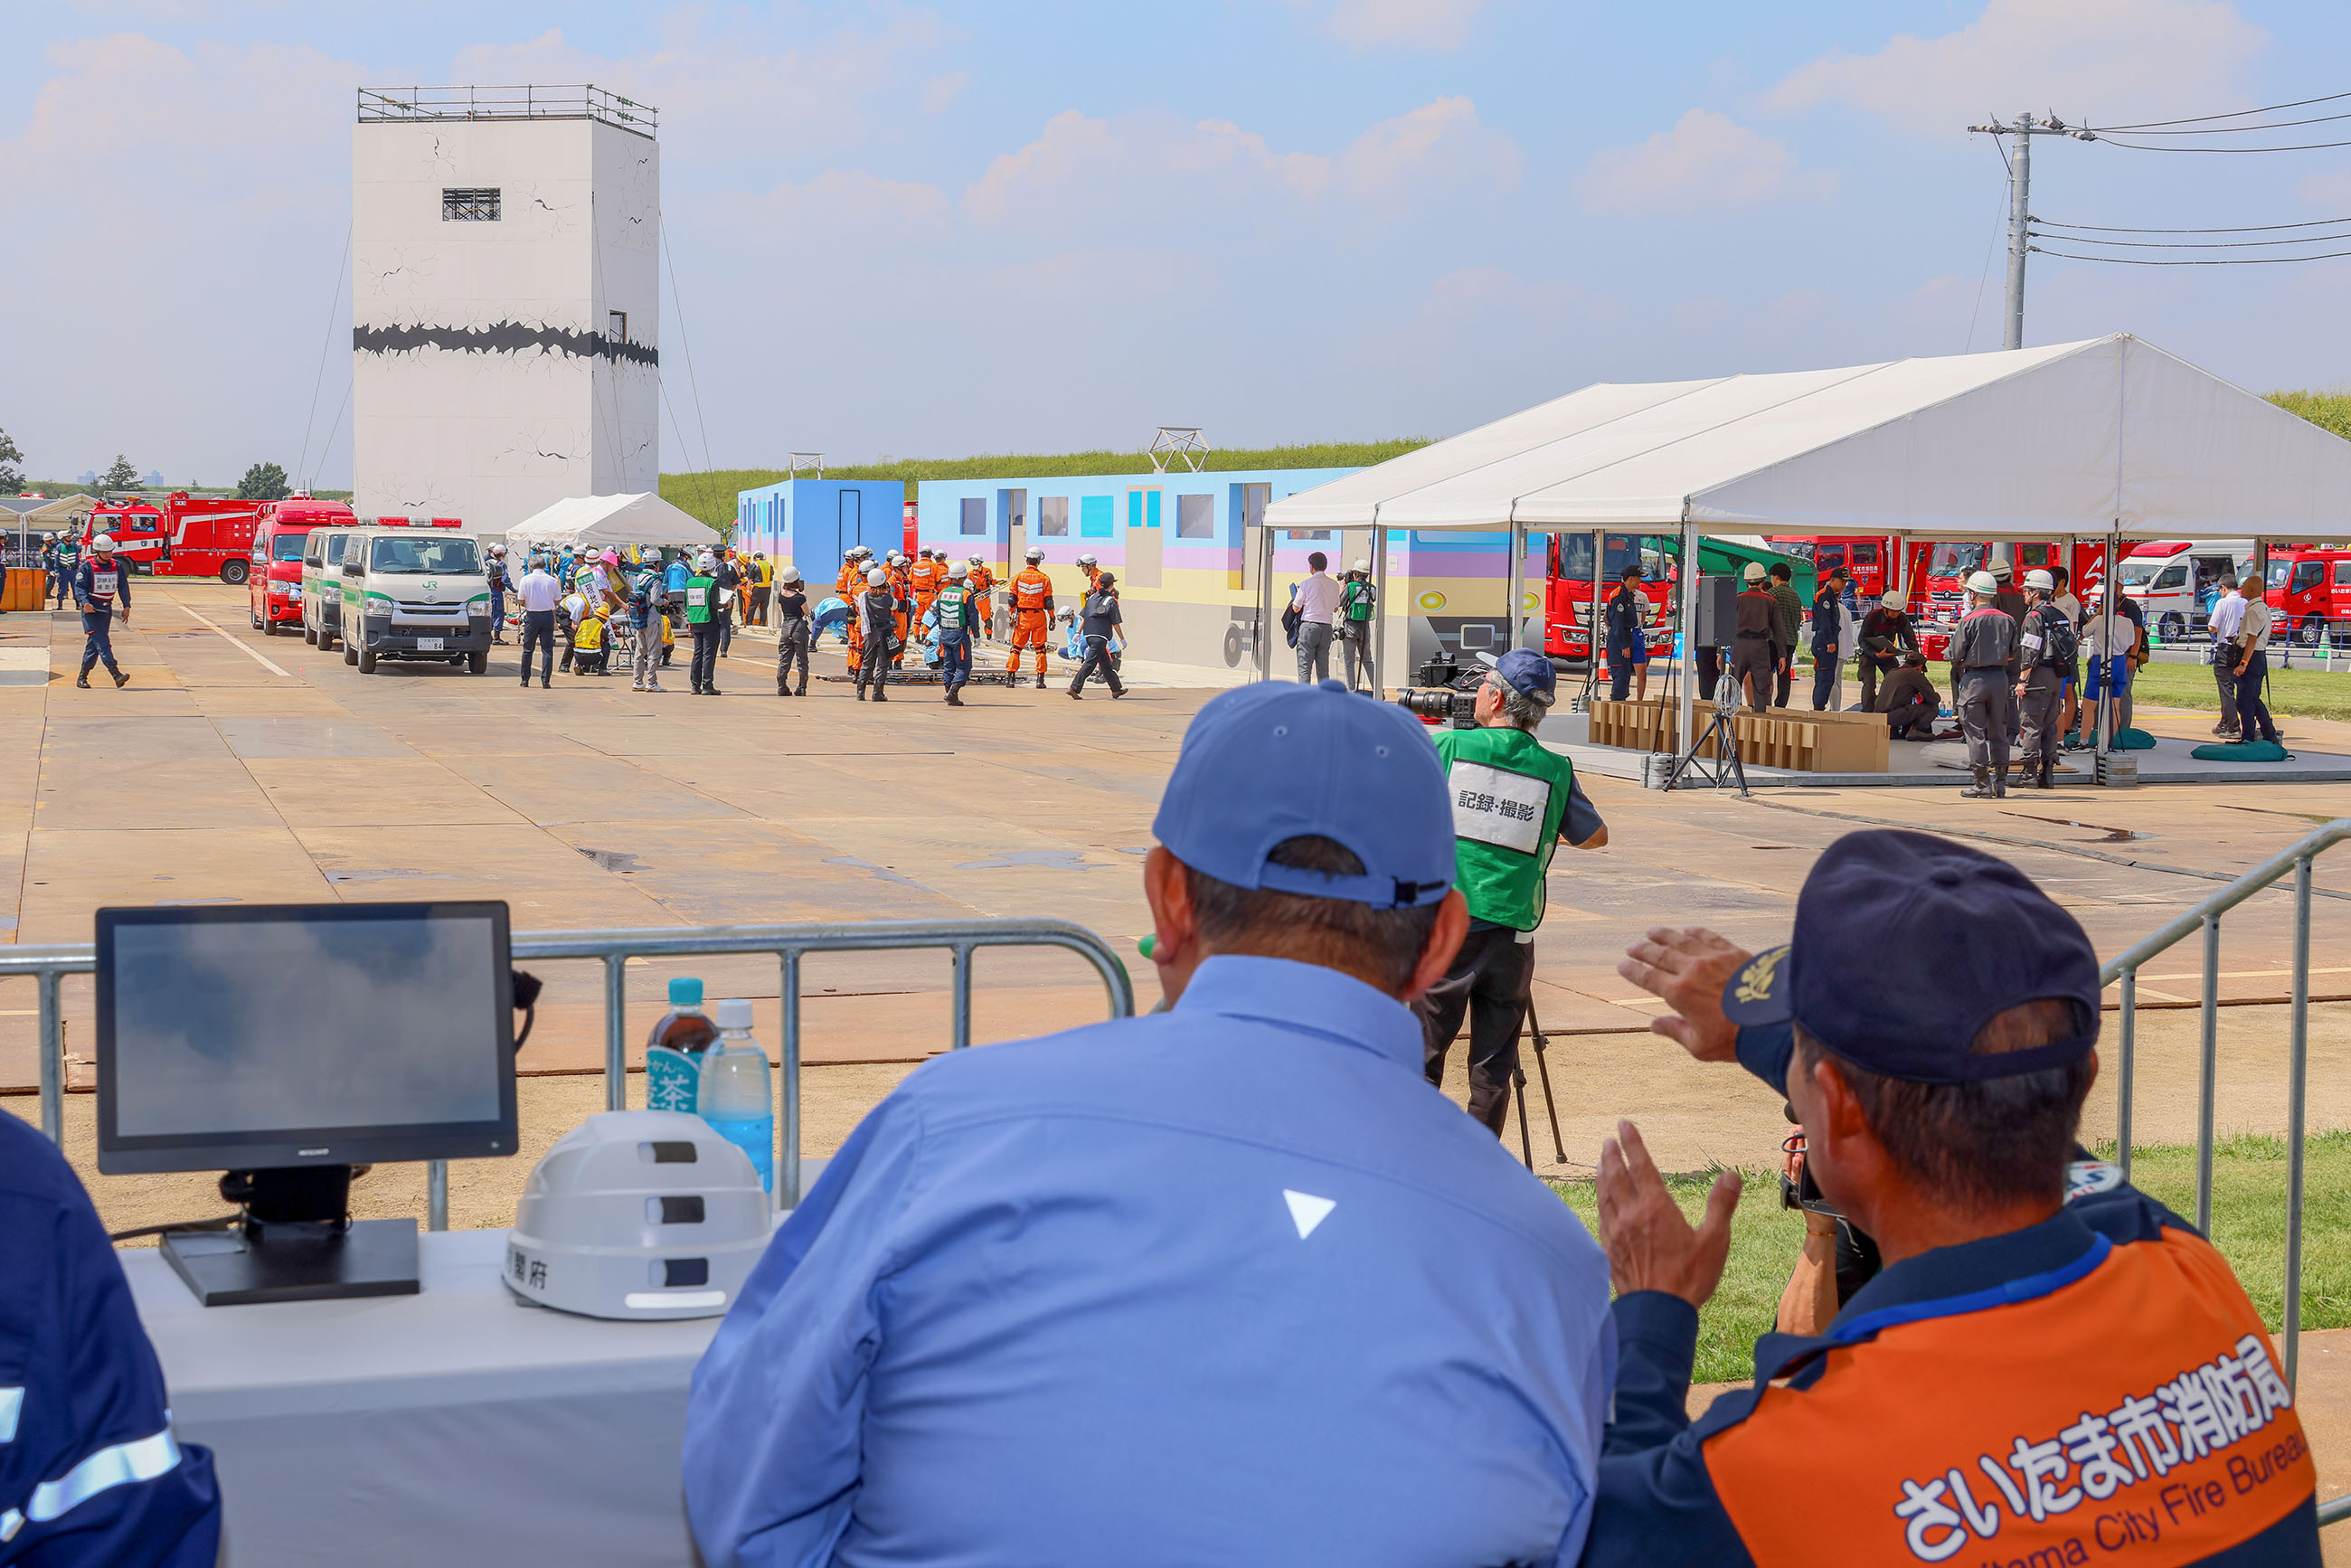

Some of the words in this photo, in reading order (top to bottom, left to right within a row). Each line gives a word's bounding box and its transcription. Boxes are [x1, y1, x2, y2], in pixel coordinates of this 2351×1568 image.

[422, 581, 438, 589] JR
[1458, 789, 1535, 822] 記録・撮影
[1894, 1333, 2292, 1563] さいたま市消防局
[2094, 1506, 2160, 1553] City
[2159, 1480, 2226, 1527] Fire
